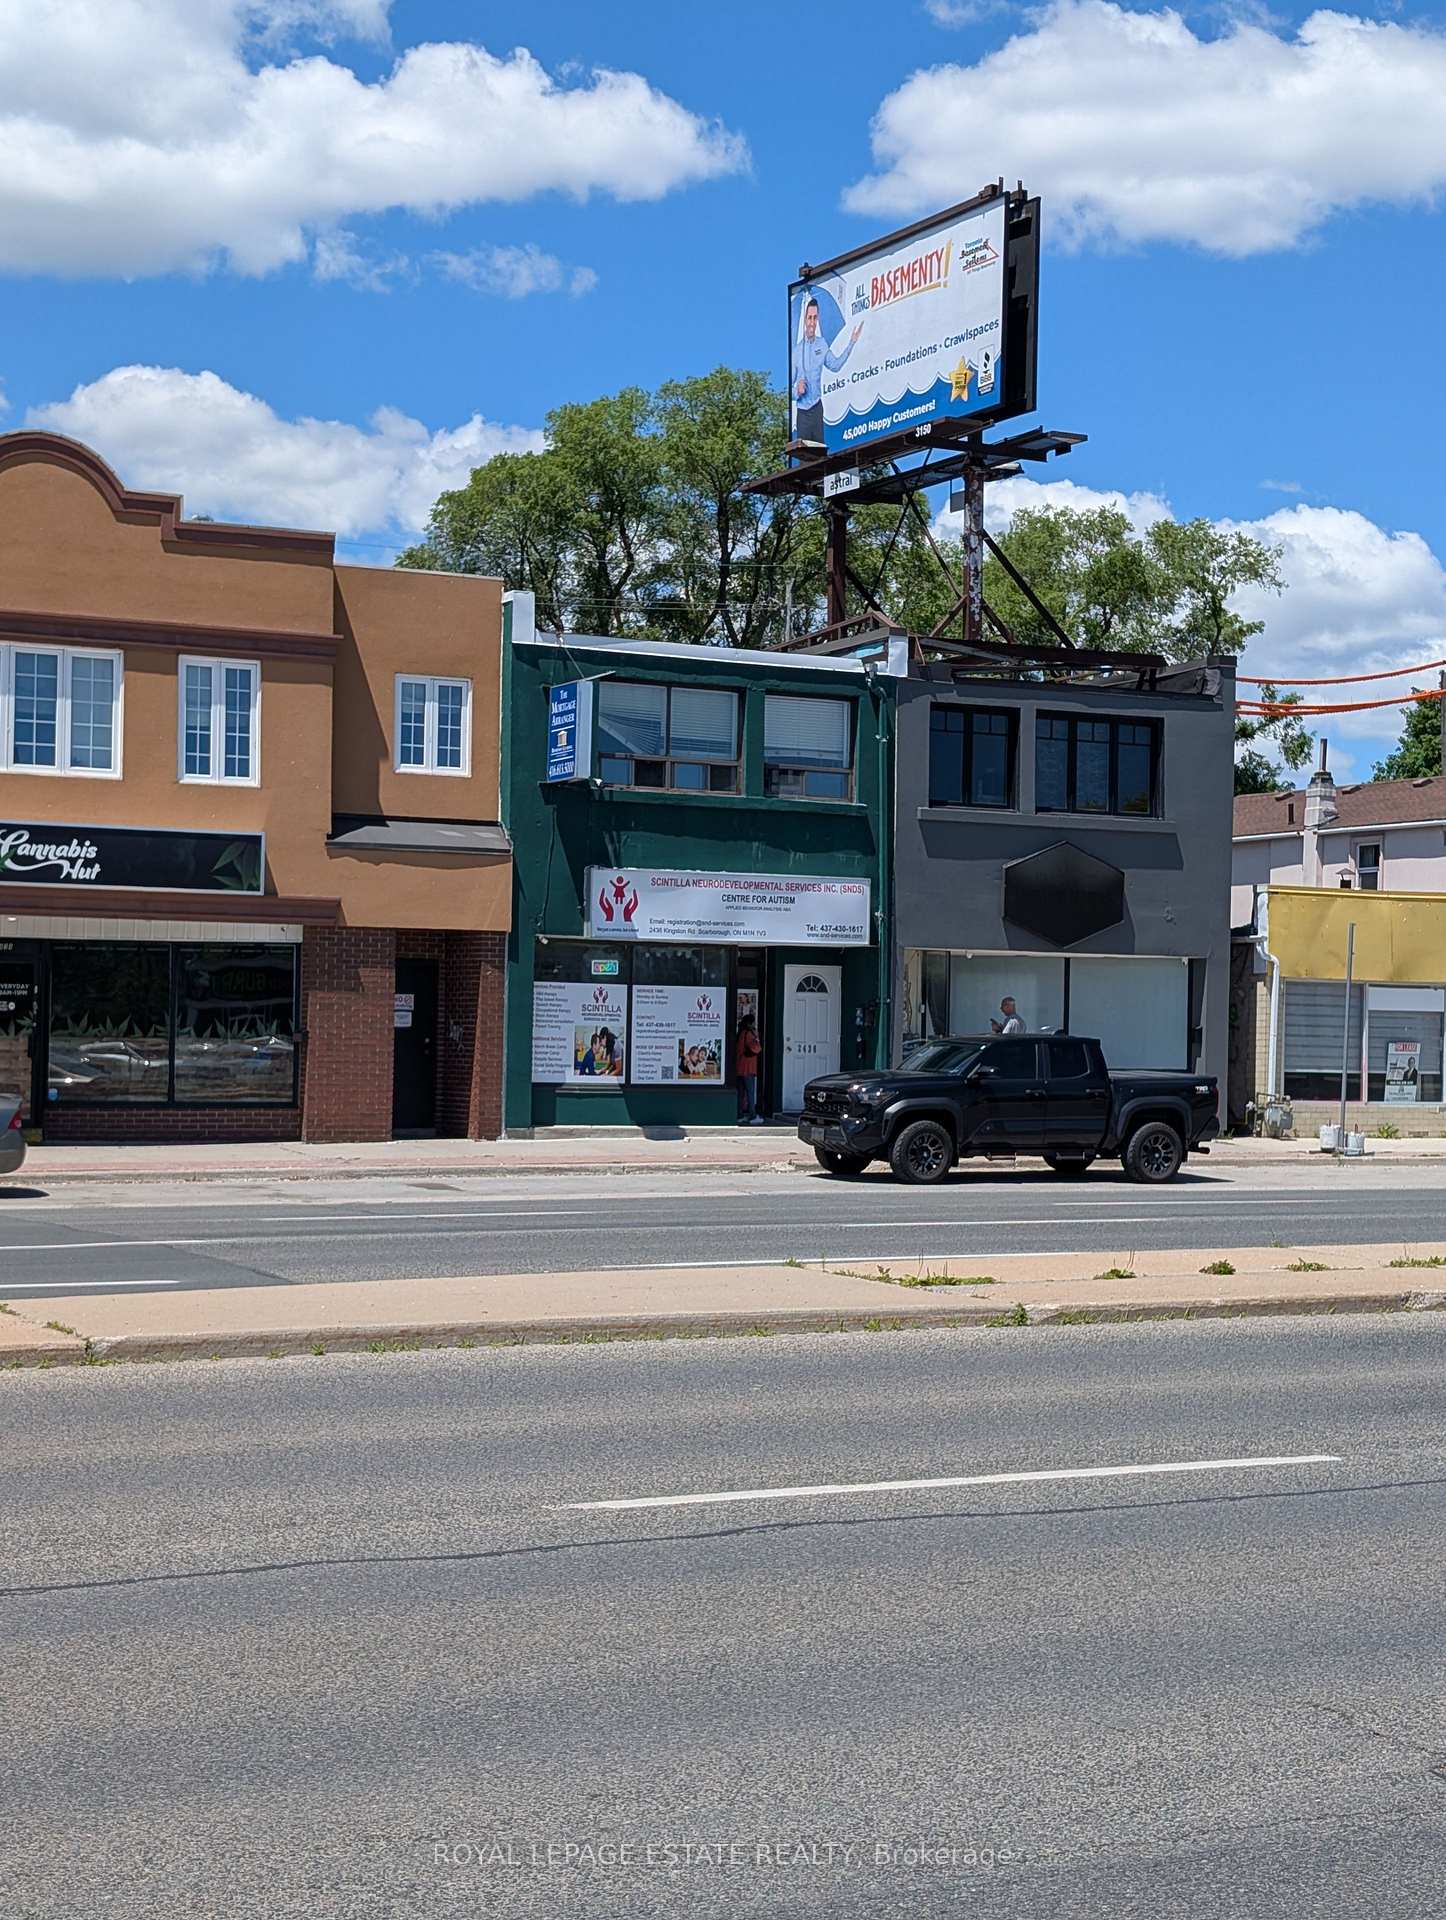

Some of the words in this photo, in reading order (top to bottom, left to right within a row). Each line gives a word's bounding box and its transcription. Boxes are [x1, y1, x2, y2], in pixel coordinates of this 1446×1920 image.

[871, 238, 954, 308] BASEMENTY!
[855, 283, 865, 300] ALL
[851, 295, 870, 316] THINGS
[823, 378, 845, 395] Leaks
[851, 365, 879, 384] Cracks
[885, 343, 937, 371] Foundations
[944, 319, 999, 349] Crawlspaces
[842, 423, 867, 440] 45,000
[868, 416, 892, 432] Happy
[893, 400, 936, 423] Customers!
[915, 423, 932, 438] 3150
[830, 475, 852, 491] astral
[0, 829, 98, 860] Cannabis
[651, 877, 690, 888] SCINTILLA
[693, 879, 783, 892] NEURODEVELOPMENTAL
[785, 883, 822, 892] SERVICES
[824, 885, 838, 893] INC.
[840, 885, 865, 896] (SNDS)
[722, 894, 751, 903] CENTRE
[752, 895, 767, 904] FOR
[768, 896, 796, 905] AUTISM
[664, 928, 686, 937] Kingston
[806, 924, 818, 932] Tel:
[581, 1004, 622, 1014] SCINTILLA
[688, 1012, 720, 1020] SCINTILLA
